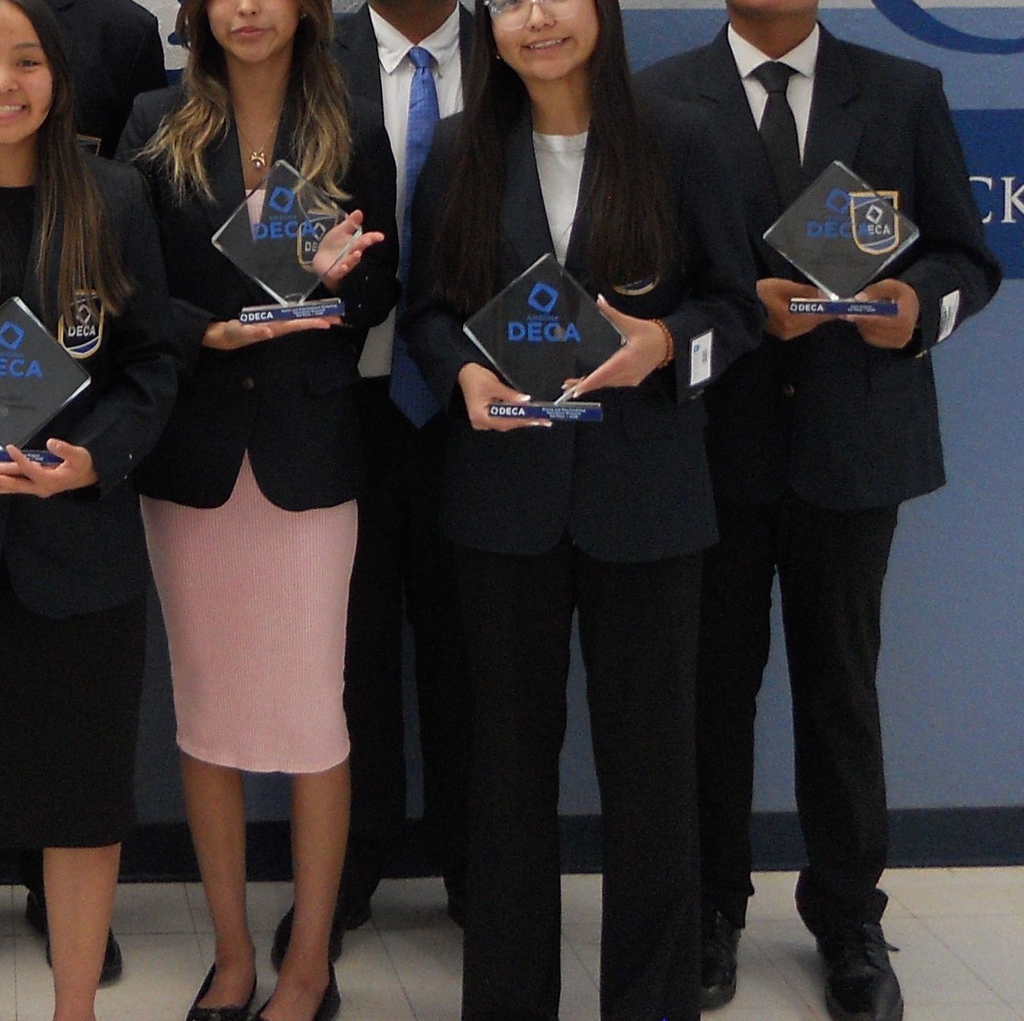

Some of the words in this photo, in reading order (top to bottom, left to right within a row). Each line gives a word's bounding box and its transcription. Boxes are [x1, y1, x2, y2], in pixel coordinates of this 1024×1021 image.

[253, 220, 316, 240] DECA
[798, 303, 824, 312] DECA
[248, 311, 274, 321] DECA
[67, 325, 97, 338] DECA
[508, 322, 581, 342] DECA
[499, 406, 525, 415] DECA
